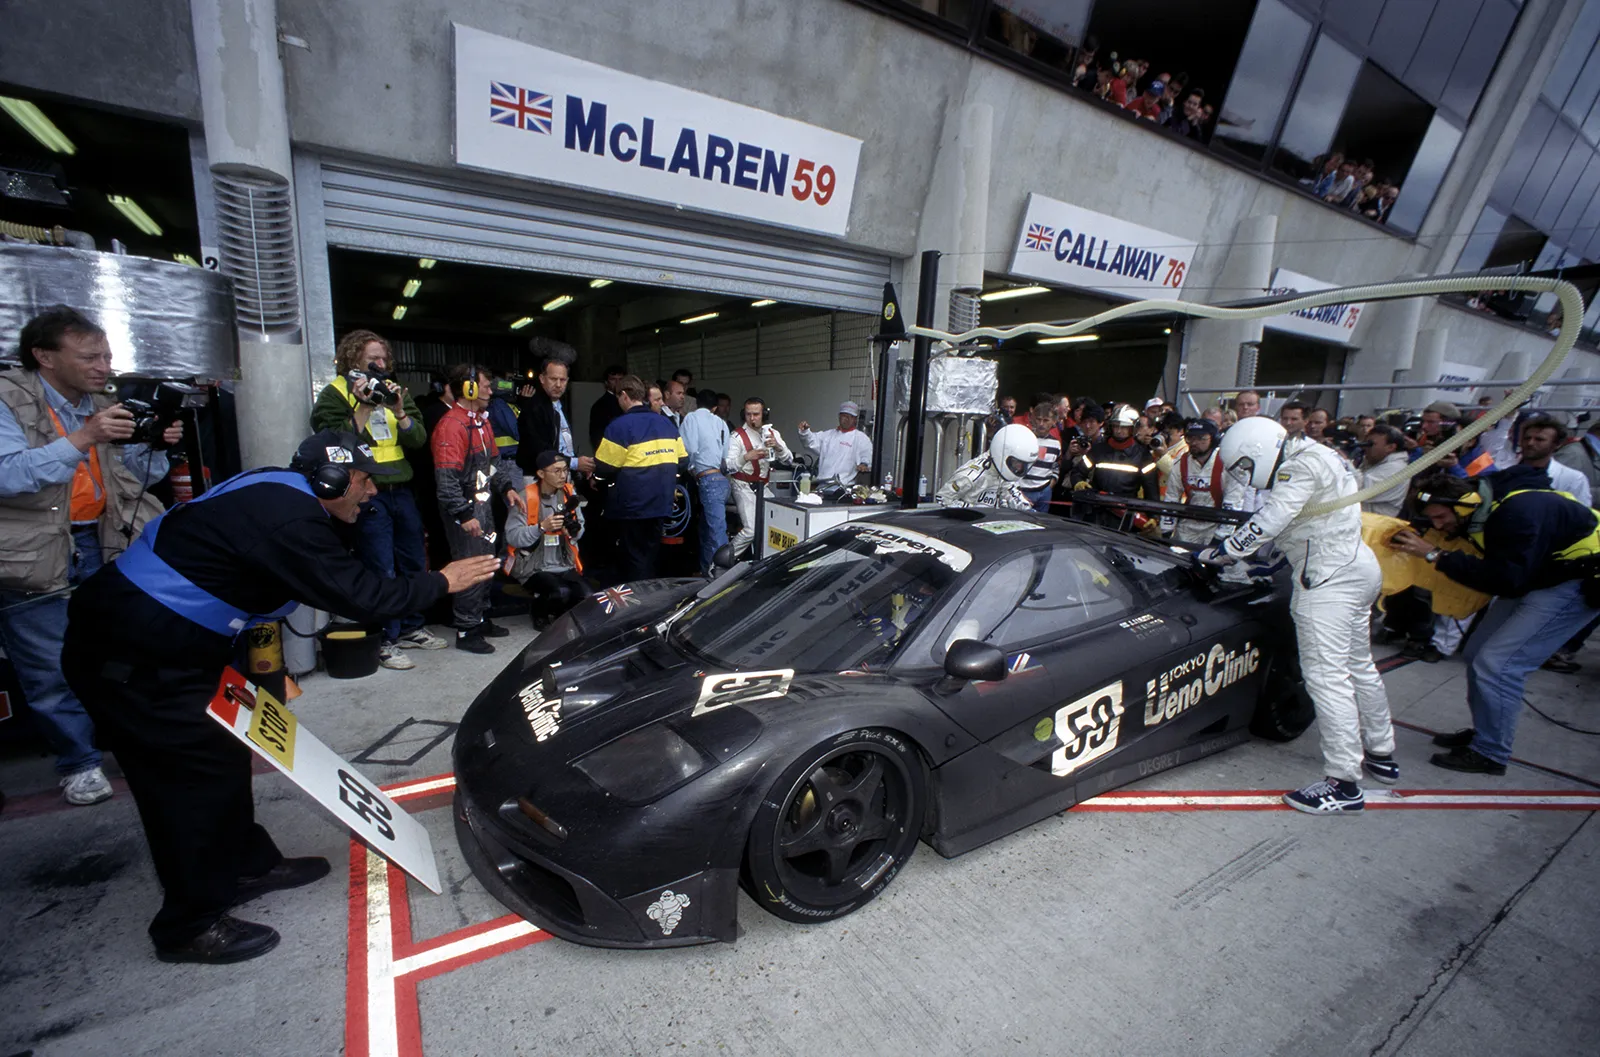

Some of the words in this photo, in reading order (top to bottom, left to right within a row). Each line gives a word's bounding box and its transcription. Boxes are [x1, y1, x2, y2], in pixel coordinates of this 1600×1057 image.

[564, 94, 790, 197] McLAREN
[791, 158, 836, 206] 59
[1054, 228, 1165, 282] CALLAWAY
[1162, 258, 1186, 288] 76
[1343, 306, 1360, 329] 75
[645, 448, 675, 456] MICHELIN
[1169, 653, 1206, 682] TOKYO
[704, 674, 784, 708] 59
[258, 701, 289, 752] STOP
[1065, 695, 1115, 760] 59
[337, 768, 396, 841] 59
[779, 894, 833, 917] MICHELIN
